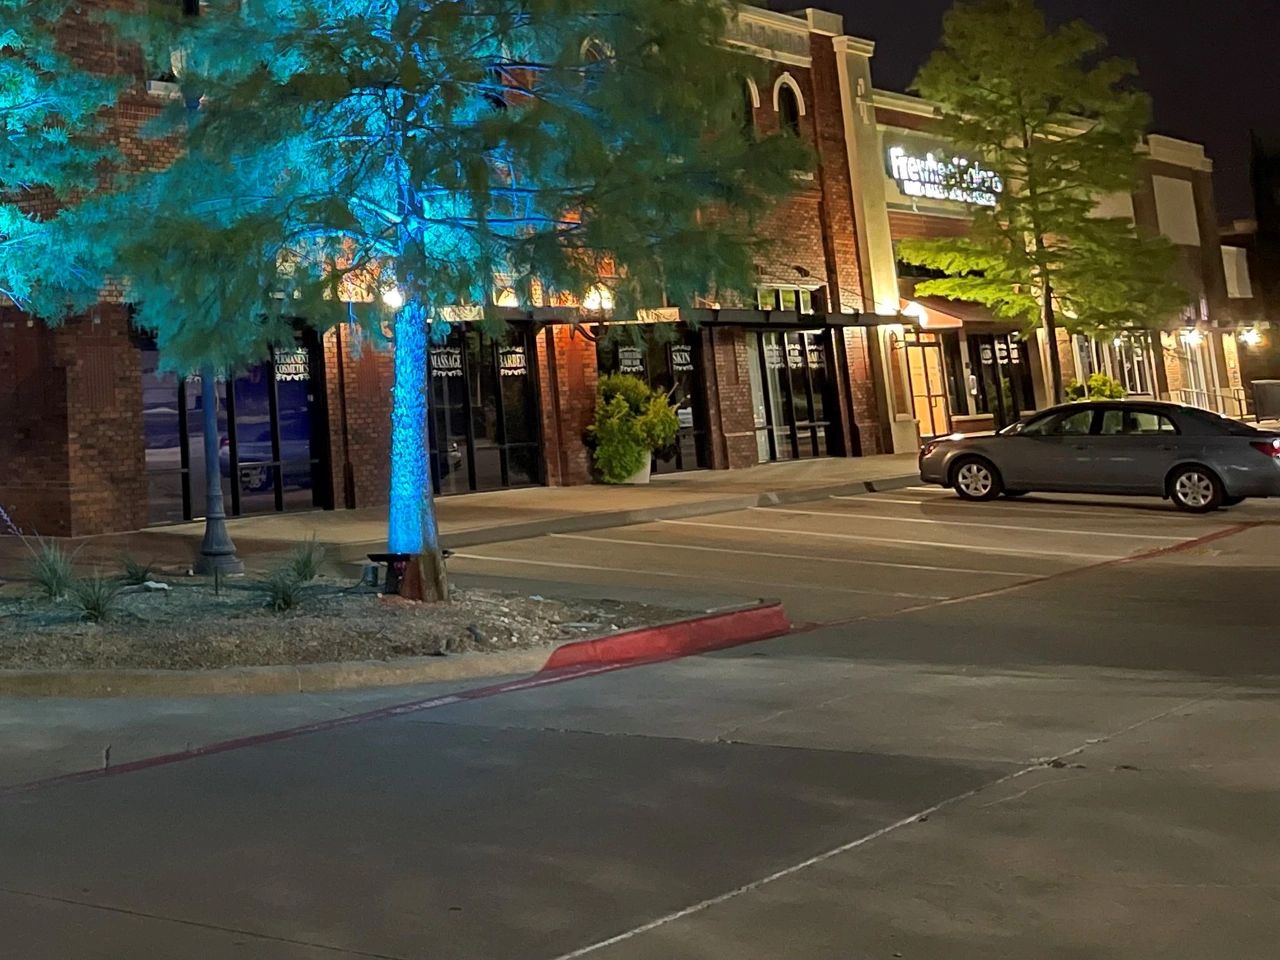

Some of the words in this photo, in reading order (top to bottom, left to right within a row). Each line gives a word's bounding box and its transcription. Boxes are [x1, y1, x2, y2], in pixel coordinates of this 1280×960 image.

[431, 353, 462, 368] MASSAGE
[499, 353, 526, 368] BARBER
[672, 351, 691, 364] SKIN
